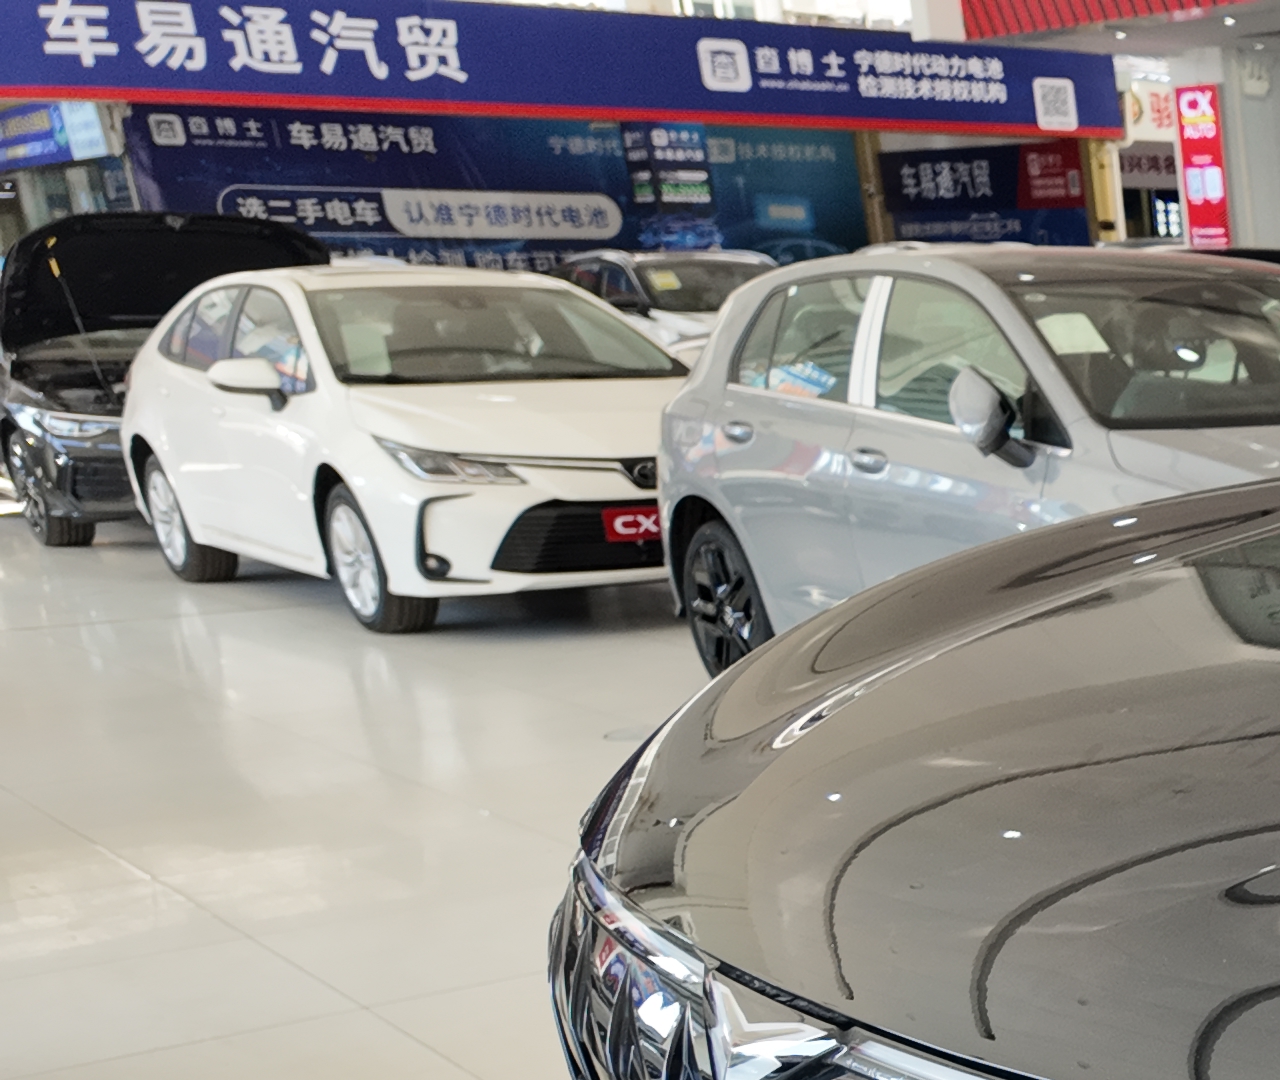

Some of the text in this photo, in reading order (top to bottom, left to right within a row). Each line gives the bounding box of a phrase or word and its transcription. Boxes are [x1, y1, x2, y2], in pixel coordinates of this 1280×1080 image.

[38, 0, 468, 84] 车易通汽贸
[1179, 90, 1215, 117] CX
[287, 121, 437, 154] 车易通汽贸
[236, 196, 610, 230] 选二手电车 认准宁德时代电池
[613, 513, 660, 535] CX
